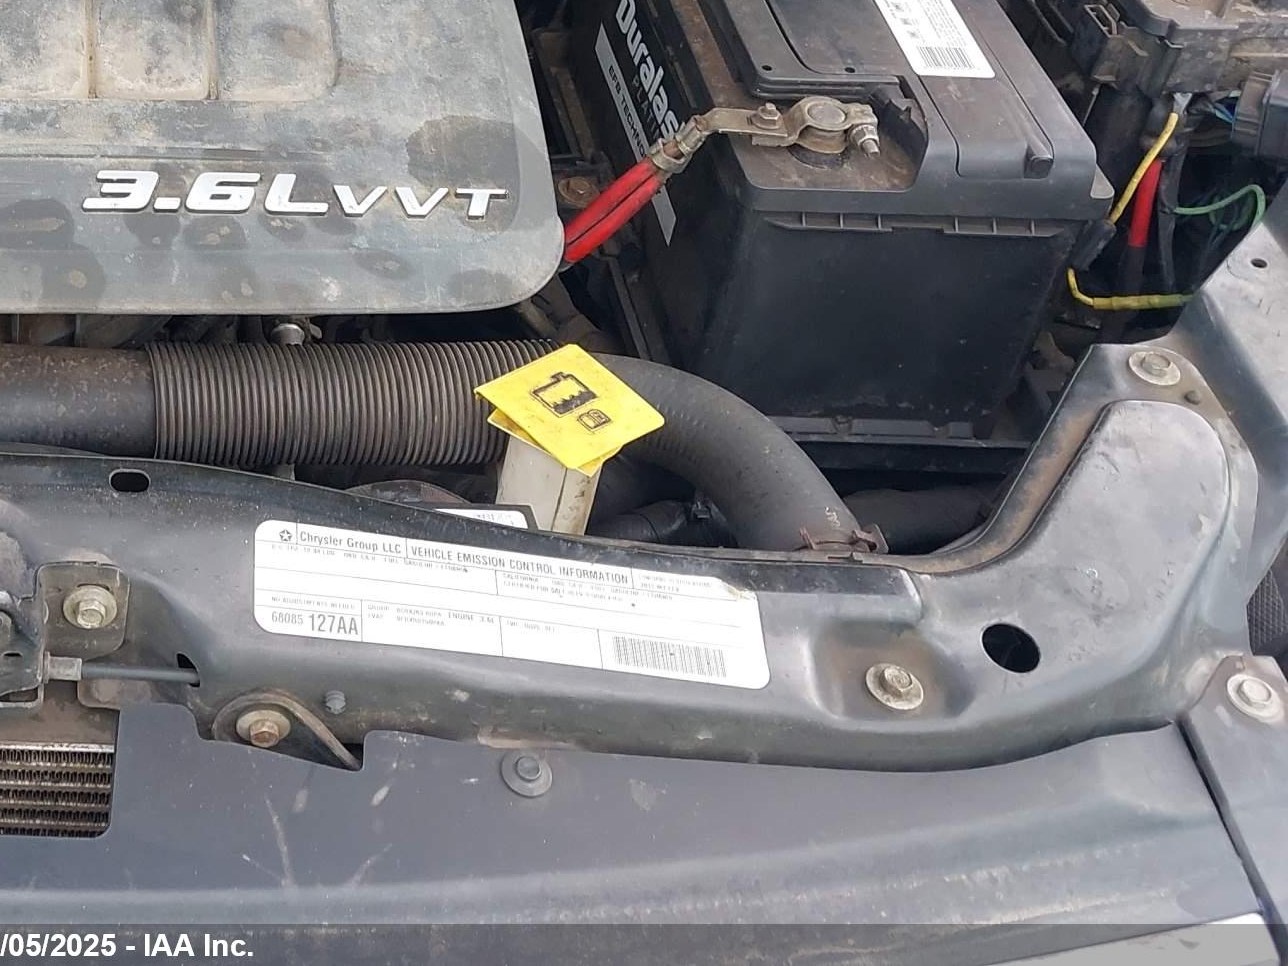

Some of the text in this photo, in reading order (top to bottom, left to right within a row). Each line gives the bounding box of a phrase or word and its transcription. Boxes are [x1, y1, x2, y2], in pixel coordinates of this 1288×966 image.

[620, 96, 646, 158] TECHNO
[333, 184, 508, 220] VVT
[300, 531, 401, 555] Chrysler Group LLC
[411, 545, 453, 561] VEHICLE
[457, 552, 505, 570] EMISSION
[509, 559, 554, 576] CONTROL
[559, 566, 628, 584] INFORMATION
[271, 611, 359, 635] 68085 127AA
